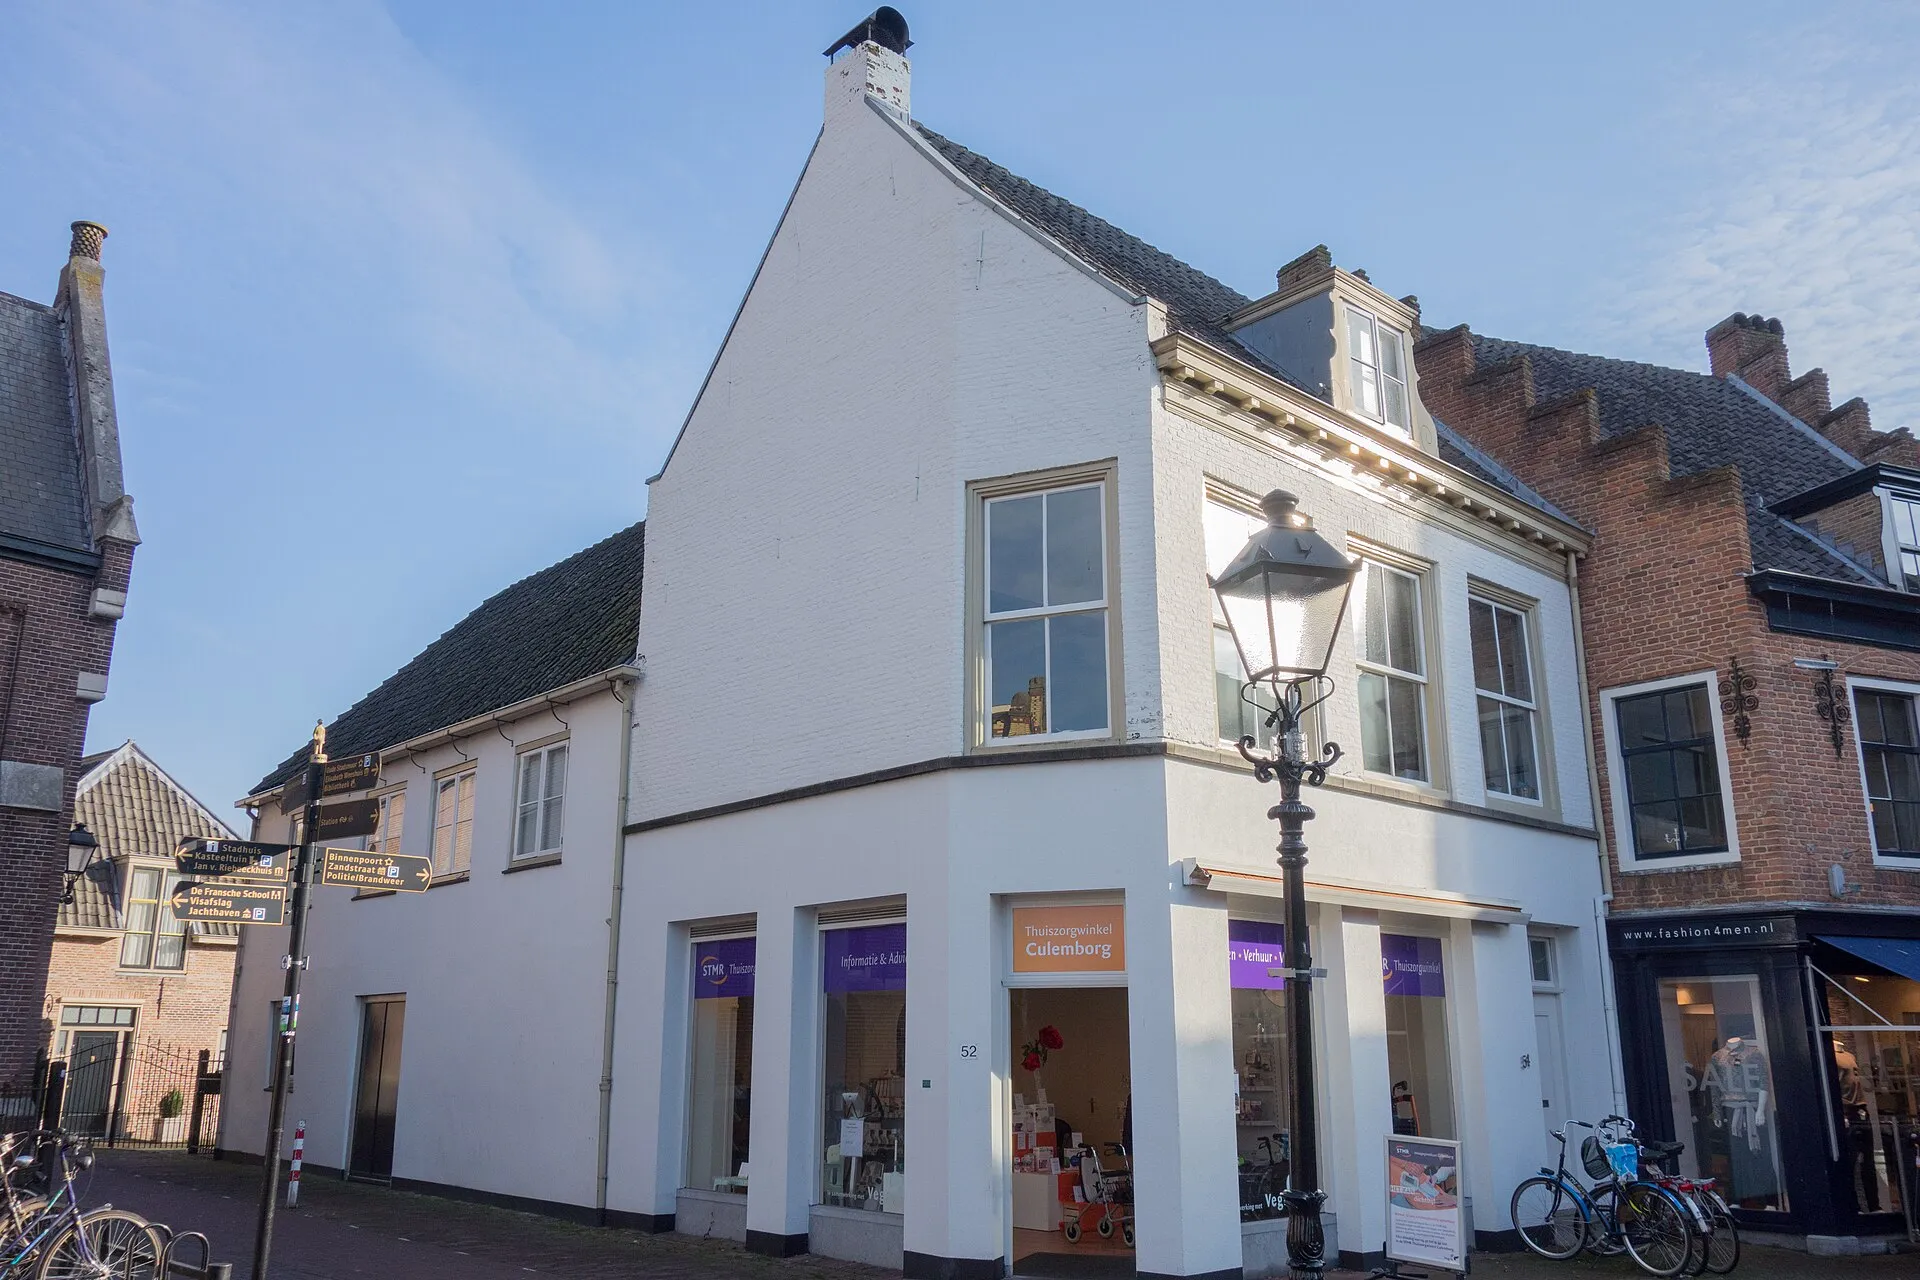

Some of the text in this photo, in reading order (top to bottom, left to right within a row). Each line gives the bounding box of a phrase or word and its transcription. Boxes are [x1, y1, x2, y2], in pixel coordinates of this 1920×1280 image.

[222, 844, 261, 855] Stadhuis
[195, 852, 247, 863] Kasteeltuin
[329, 853, 383, 866] Binnenpoort
[194, 862, 208, 871] Jan
[328, 863, 375, 874] Zandstraat
[191, 887, 270, 899] De Fransche School
[190, 897, 232, 908] Visafslag
[188, 907, 240, 917] Jachthaven
[1025, 923, 1113, 939] Thuiszorgwinkel
[1624, 922, 1774, 940] www.fashion4men.nl
[1025, 940, 1112, 959] Culemborg
[1243, 948, 1273, 963] Verhuur
[841, 953, 878, 969] Informatie
[880, 953, 887, 965] &
[1393, 959, 1440, 976] Thuiszorgwinkel
[702, 964, 725, 977] STMR
[961, 1045, 977, 1058] 52
[1681, 1061, 1760, 1093] SALE
